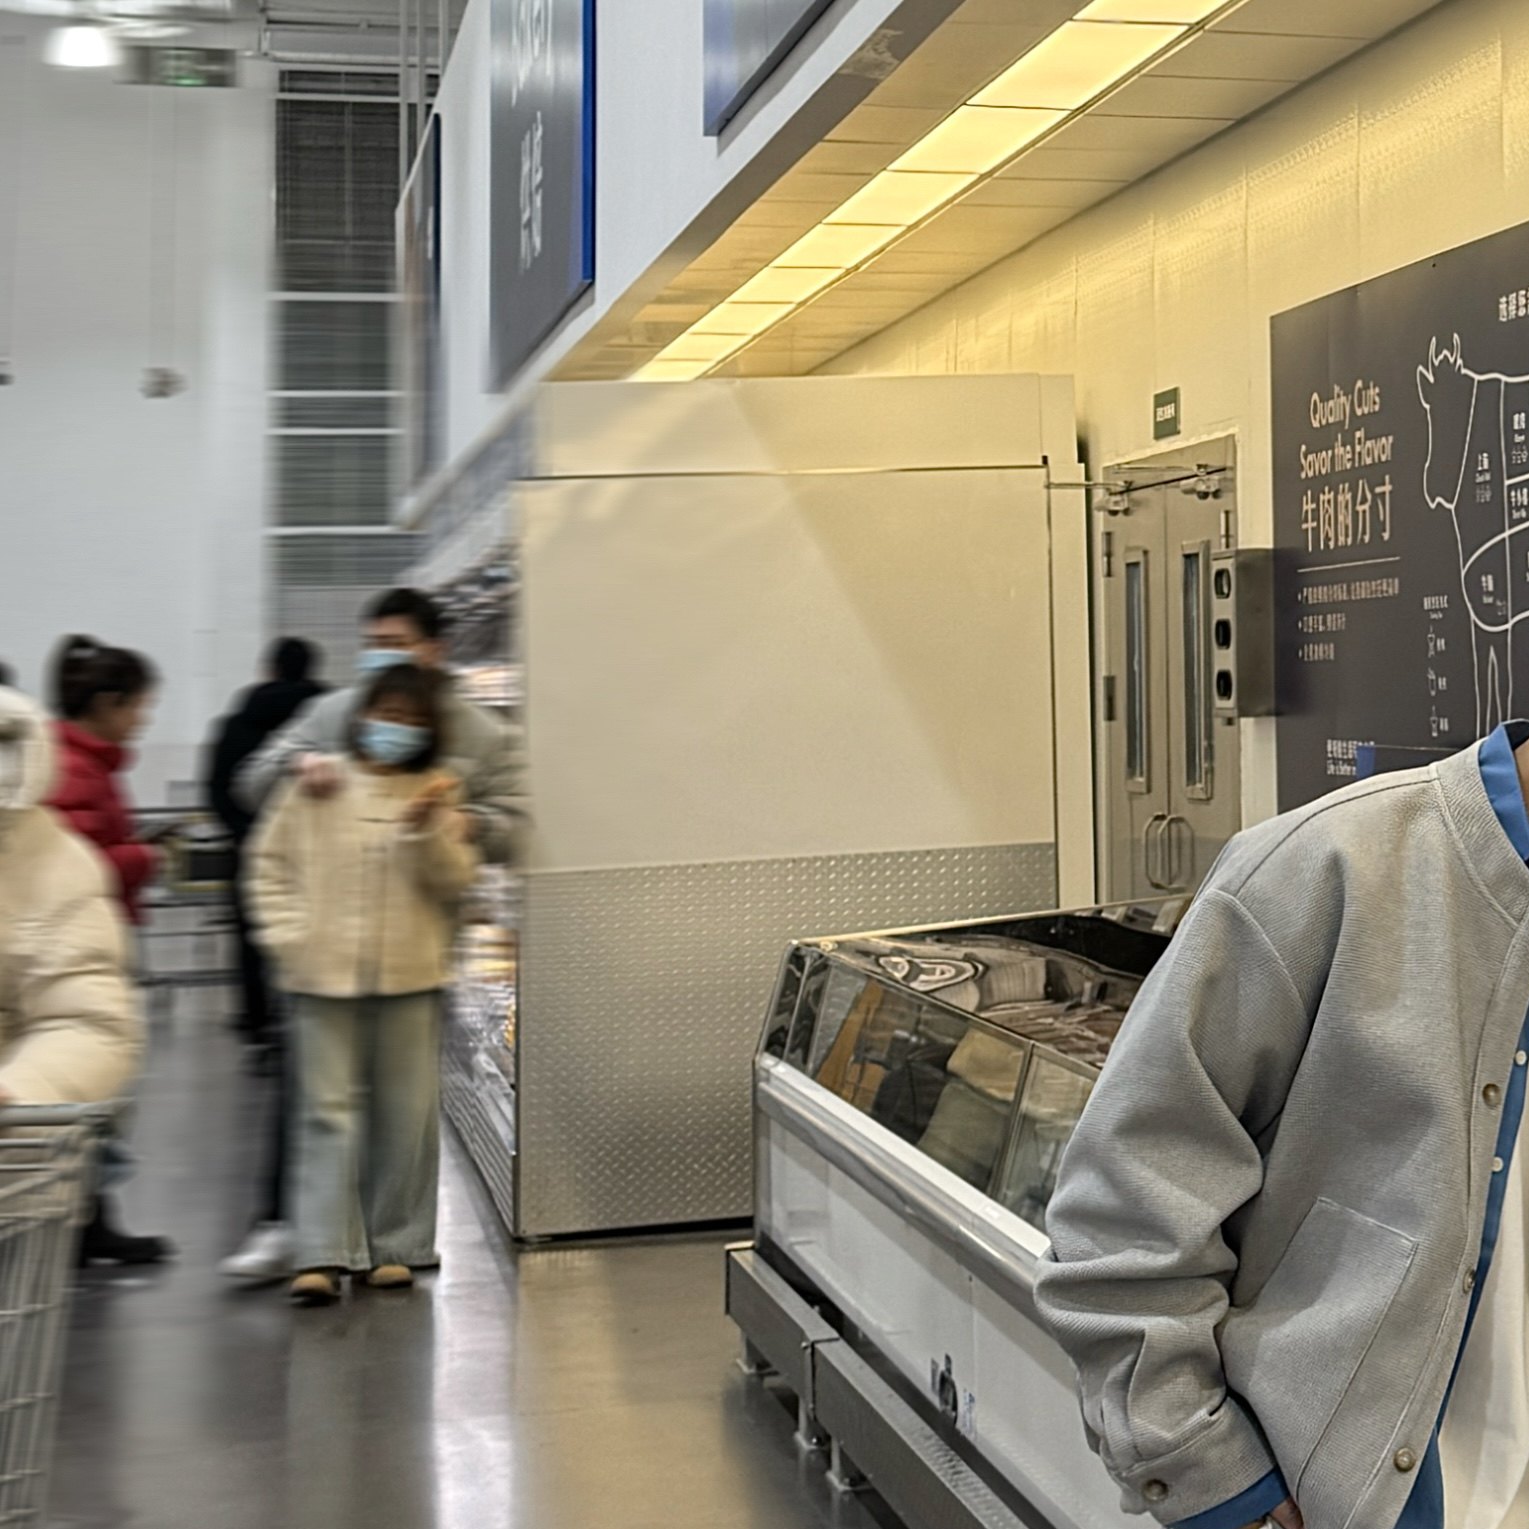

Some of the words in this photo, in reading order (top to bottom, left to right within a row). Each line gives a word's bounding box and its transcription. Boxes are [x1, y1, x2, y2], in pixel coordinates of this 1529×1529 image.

[1310, 383, 1351, 430] Quality
[1353, 379, 1380, 416] Cuts
[1300, 444, 1332, 480] Savor
[1334, 433, 1352, 472] the
[1354, 427, 1394, 467] Flavor
[1301, 474, 1393, 552] 牛肉的分寸
